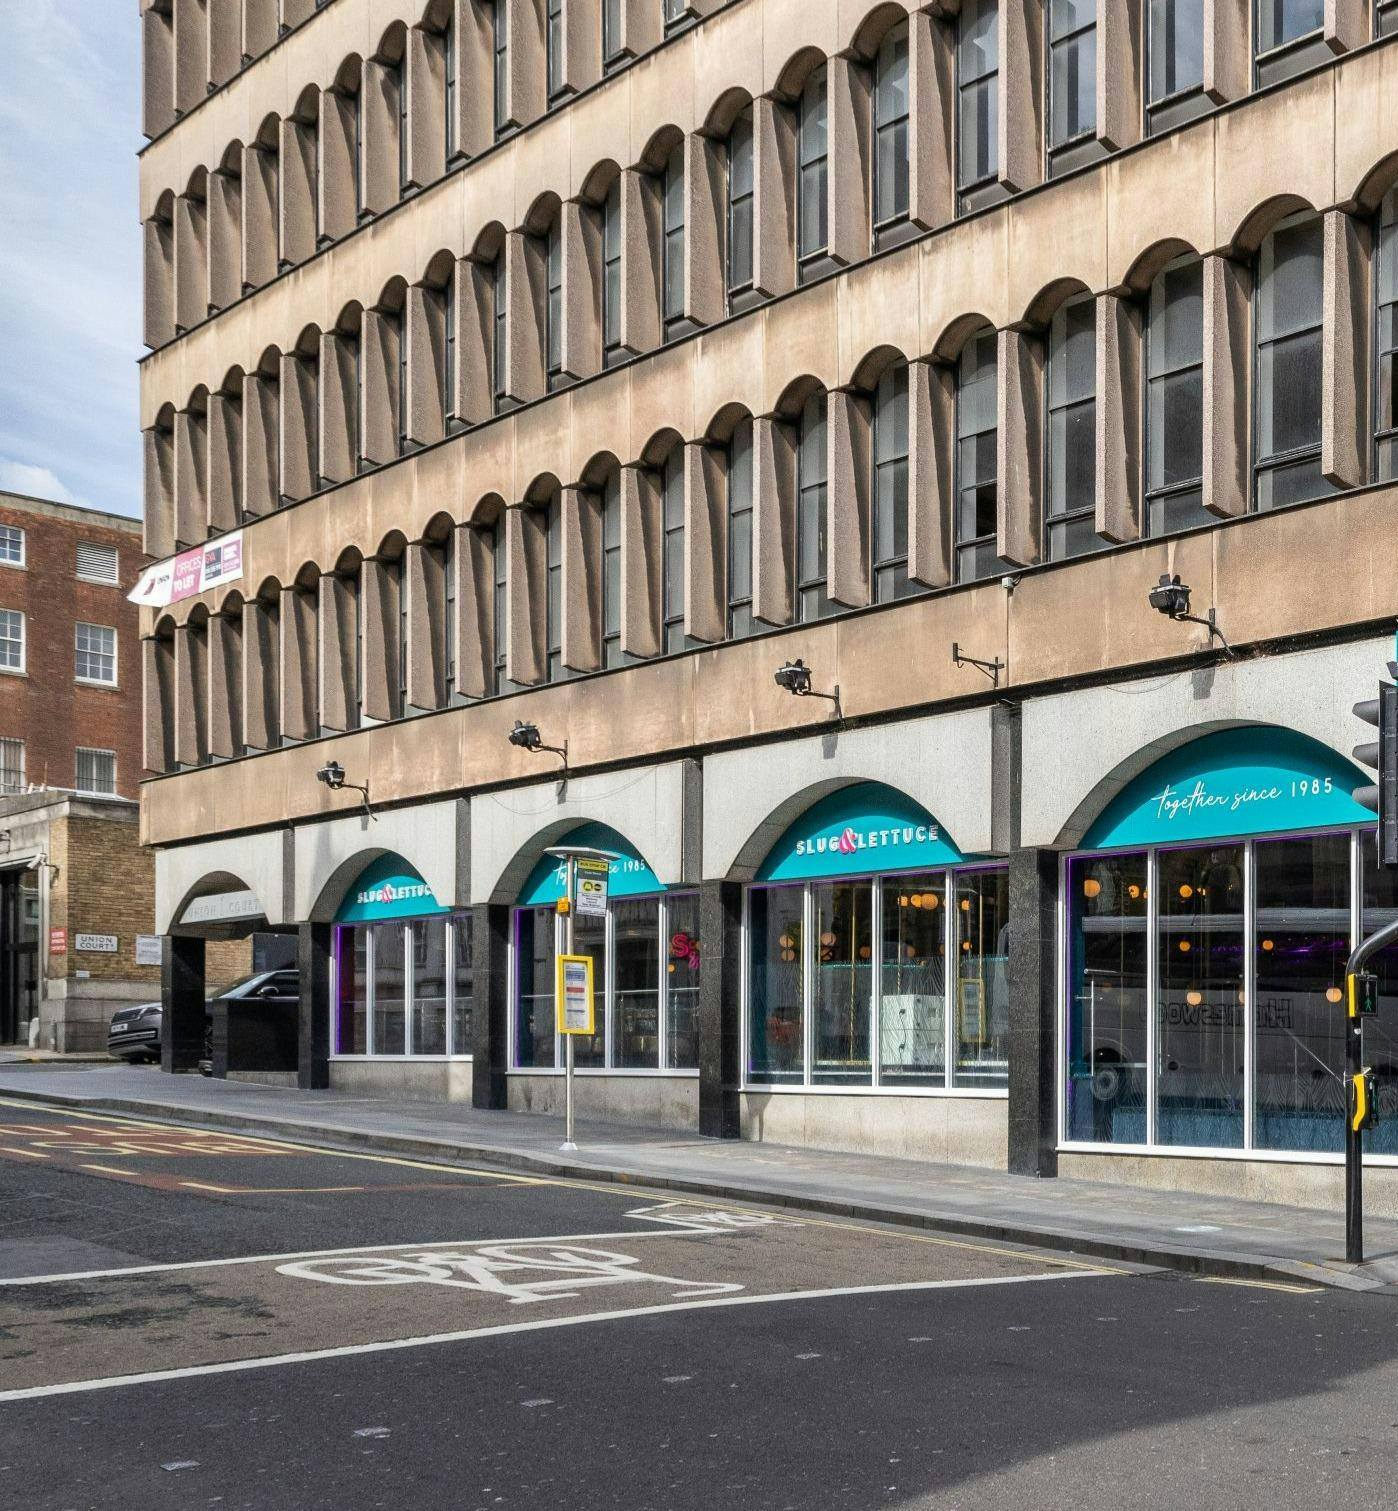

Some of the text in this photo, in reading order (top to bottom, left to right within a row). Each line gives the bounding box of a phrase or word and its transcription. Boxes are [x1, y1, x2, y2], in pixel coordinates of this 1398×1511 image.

[1150, 777, 1333, 820] together since 1985
[622, 860, 646, 872] 1985
[80, 942, 109, 950] COURT
[81, 936, 112, 944] UNION
[29, 1141, 292, 1154] BUS
